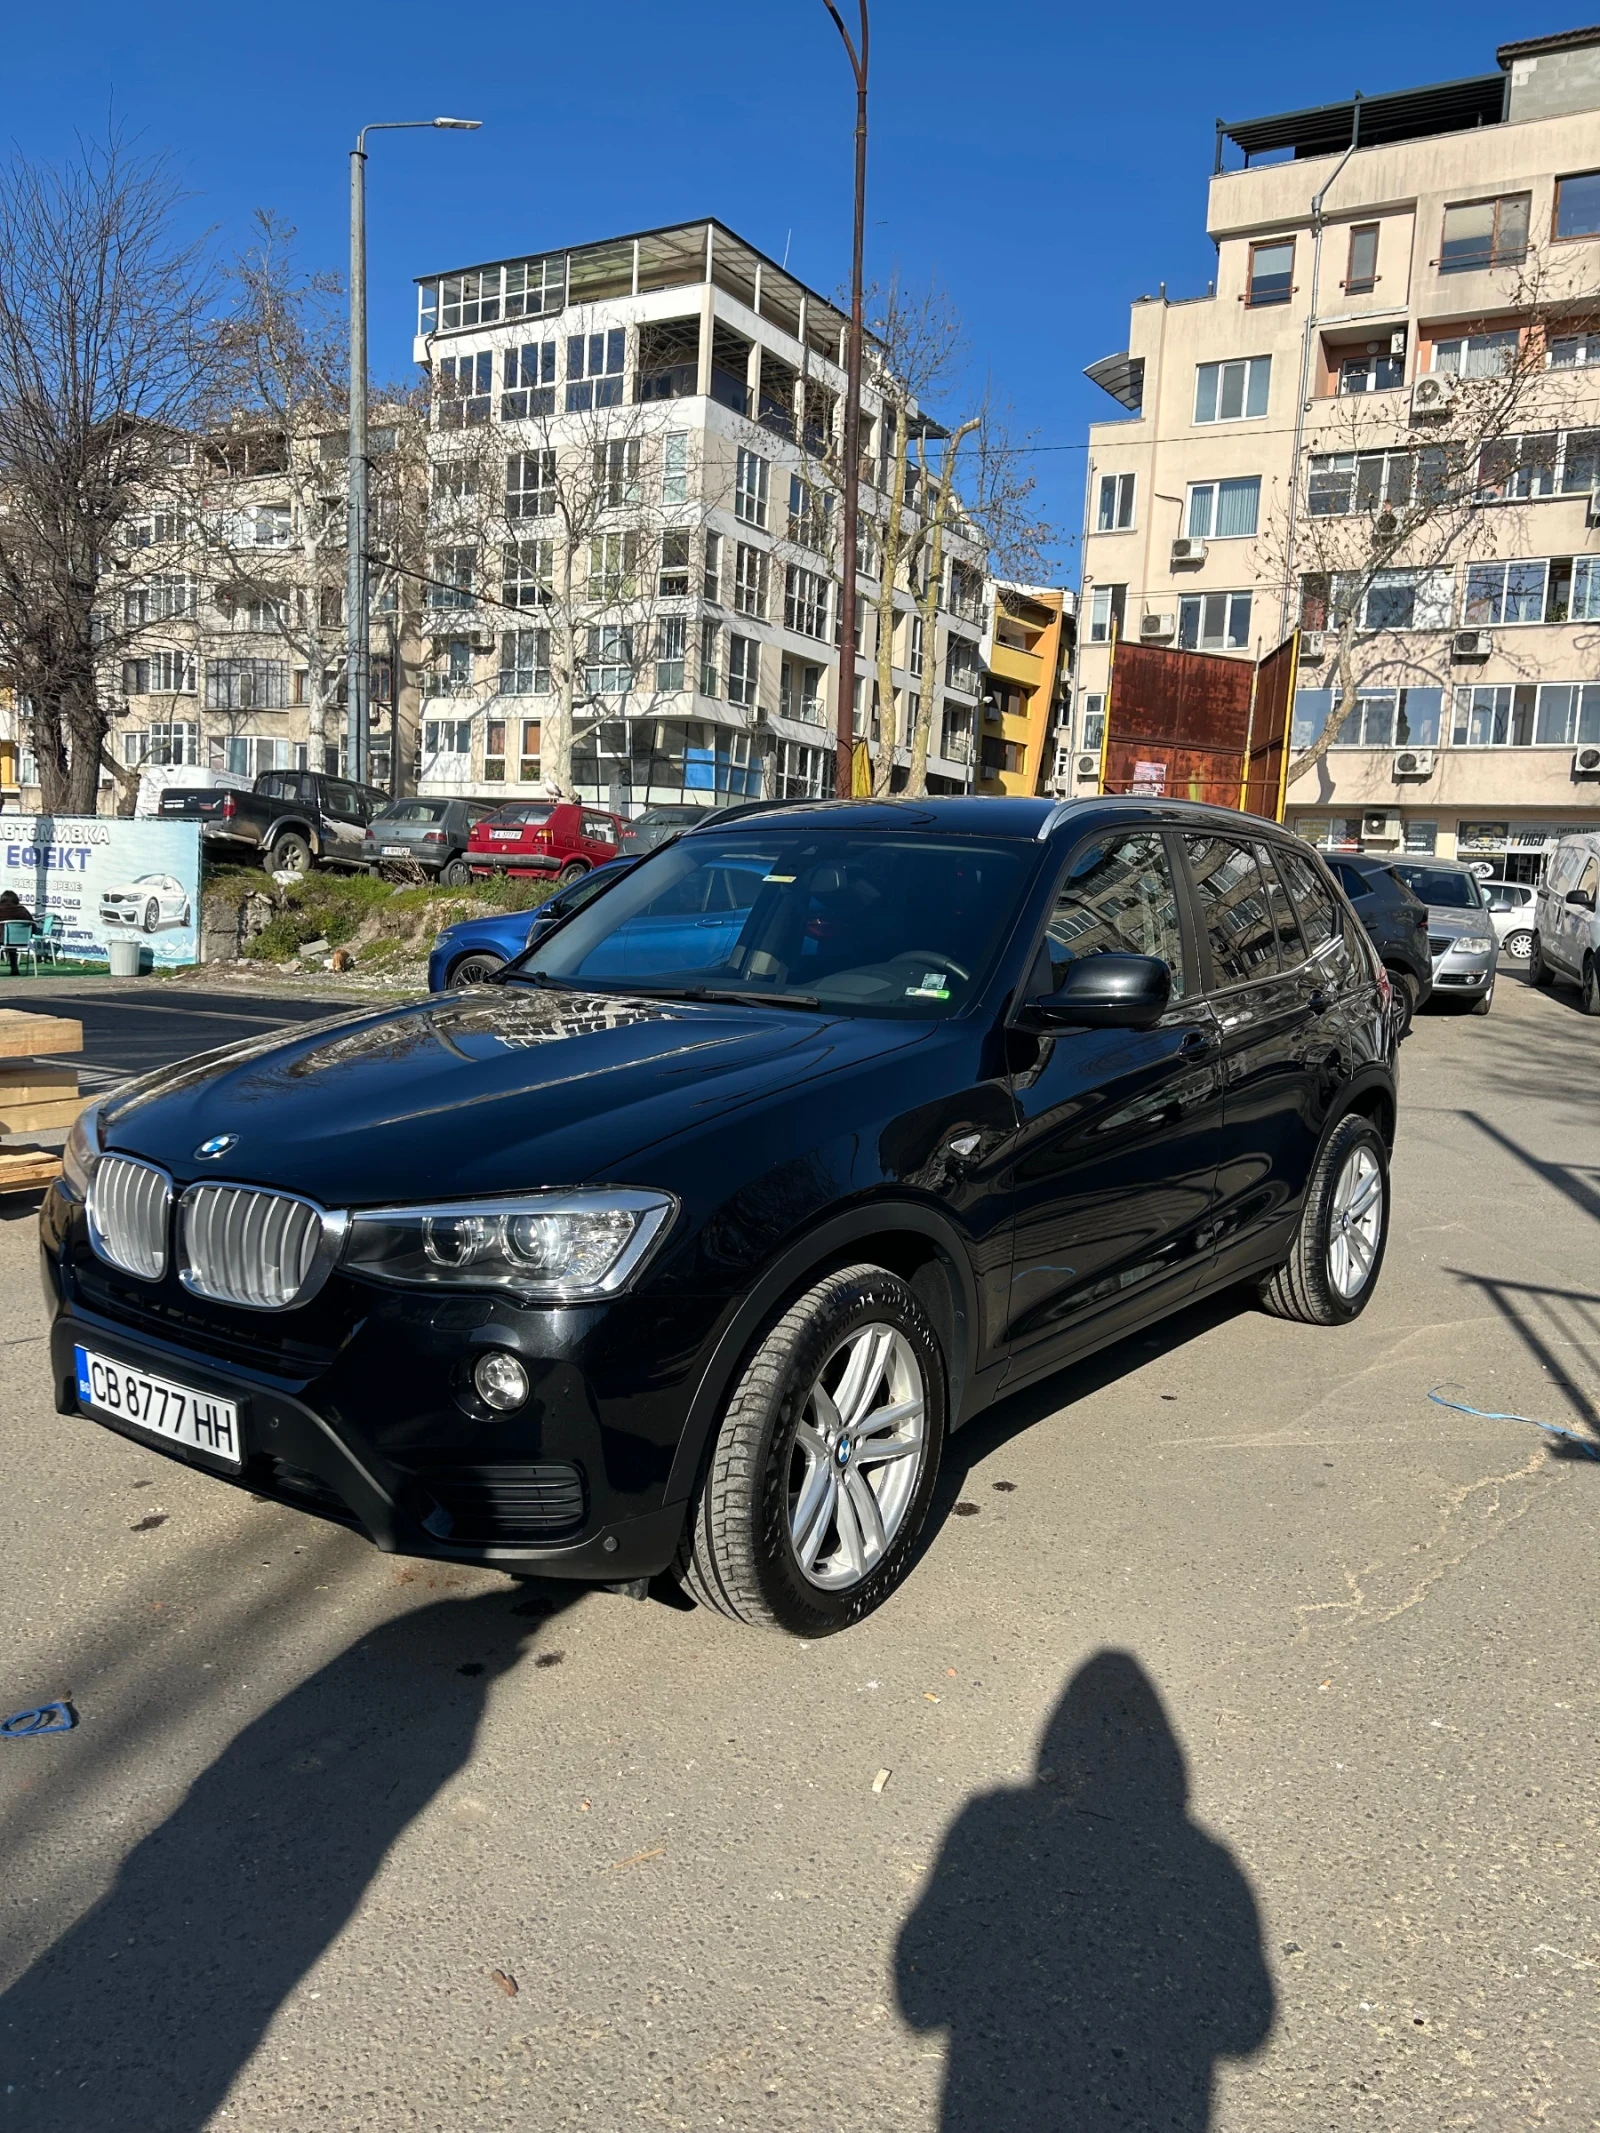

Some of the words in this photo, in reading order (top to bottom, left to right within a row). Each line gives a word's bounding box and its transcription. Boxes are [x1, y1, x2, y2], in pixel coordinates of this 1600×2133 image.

[0, 823, 110, 844] ВТОМИВКА
[6, 845, 92, 871] ЕФЕКТ
[79, 1379, 91, 1394] BG
[92, 1361, 121, 1408] CB
[126, 1376, 187, 1434] 8777
[193, 1400, 233, 1453] HH
